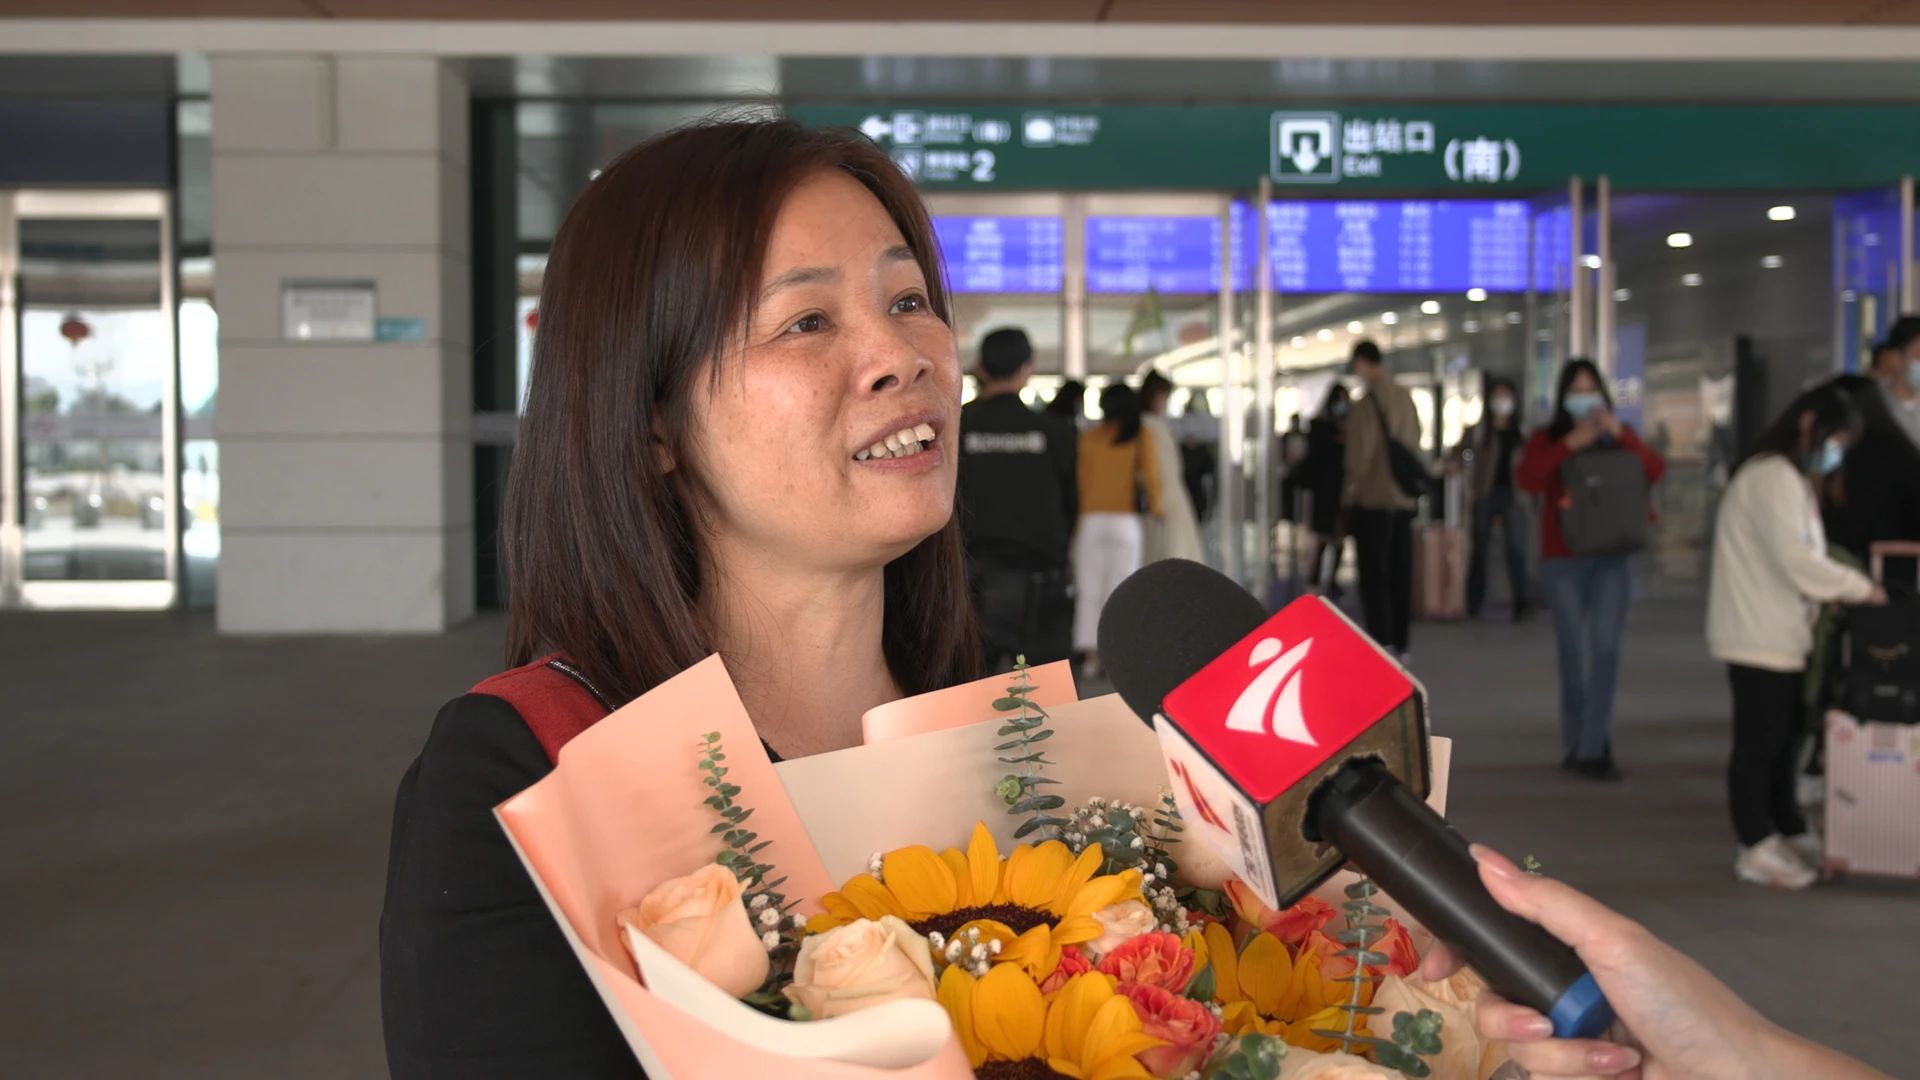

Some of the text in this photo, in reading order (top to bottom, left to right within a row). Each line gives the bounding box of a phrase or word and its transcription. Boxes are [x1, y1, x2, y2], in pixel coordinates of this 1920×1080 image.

[1343, 119, 1435, 153] 出站口
[972, 151, 995, 181] 2
[1343, 156, 1381, 177] Exit
